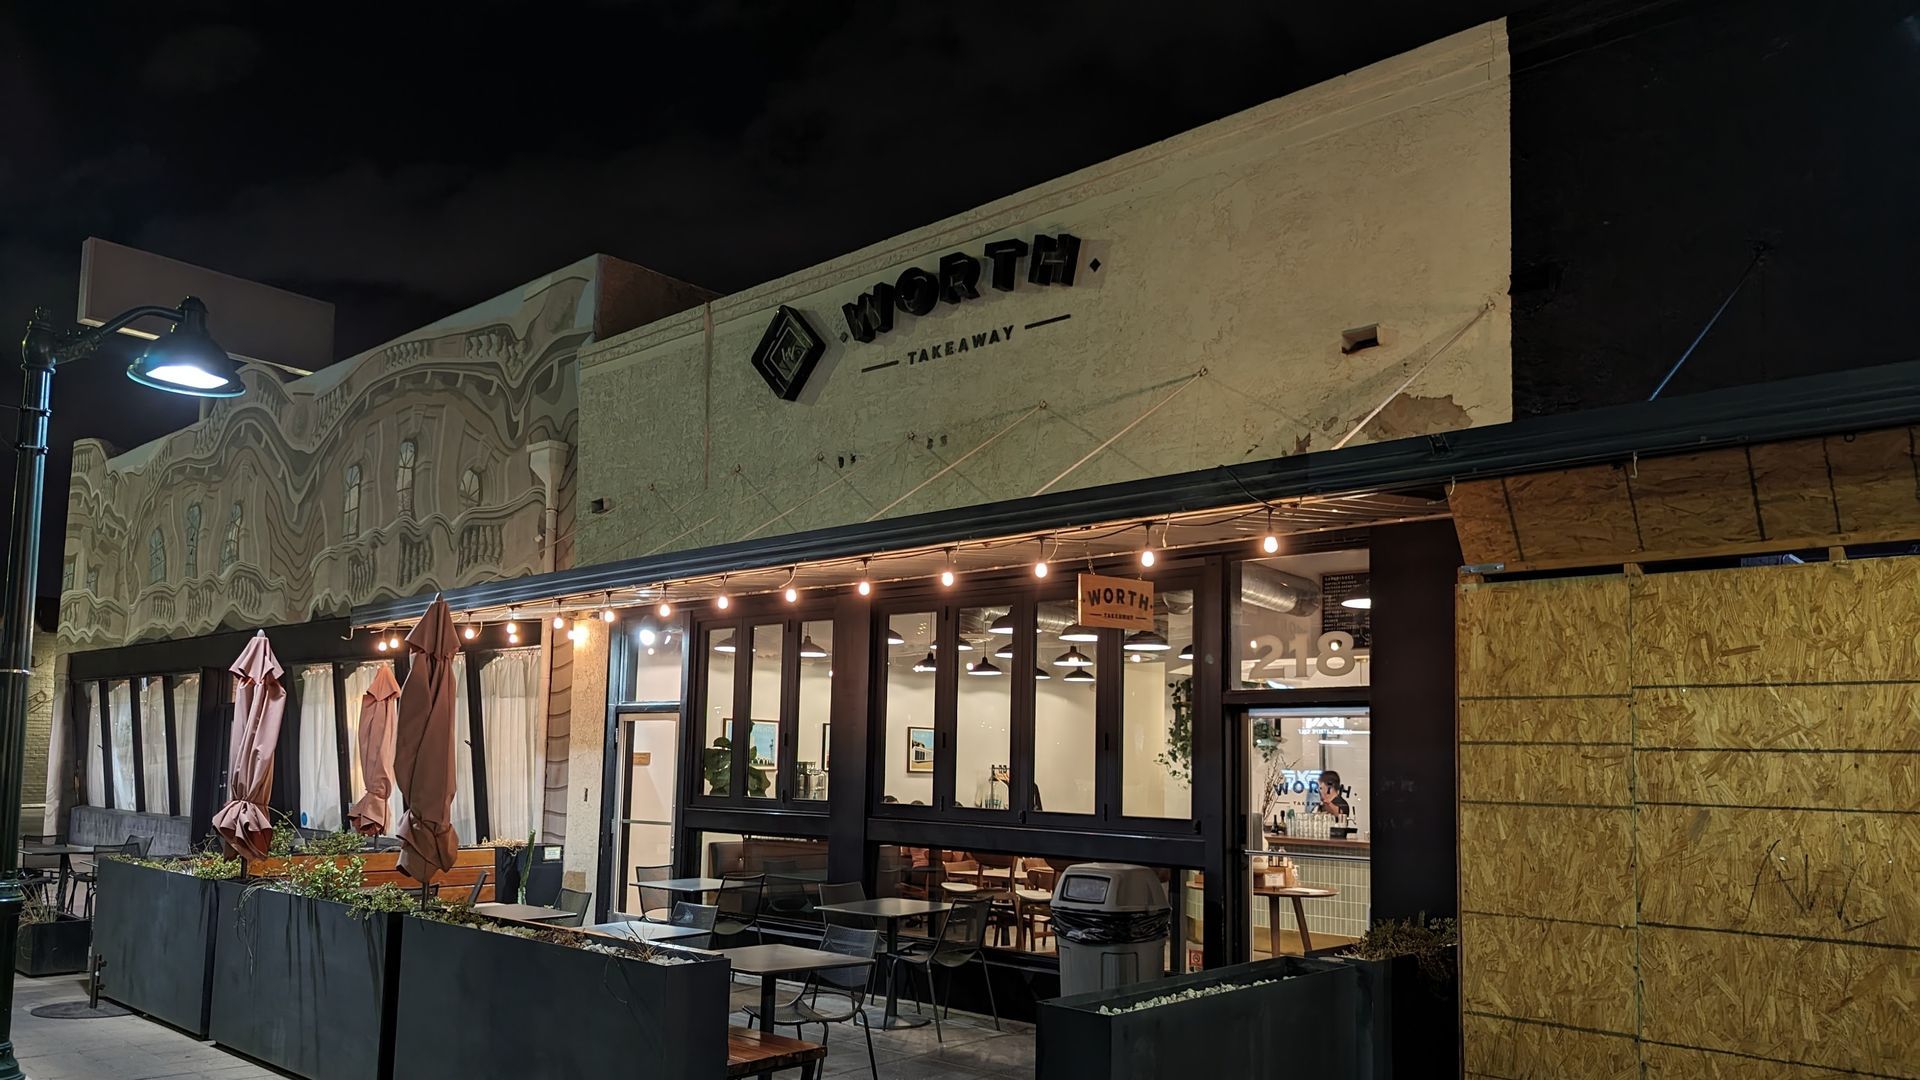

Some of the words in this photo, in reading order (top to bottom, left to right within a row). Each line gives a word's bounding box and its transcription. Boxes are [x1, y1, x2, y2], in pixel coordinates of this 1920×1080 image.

[841, 233, 1081, 343] WORTH
[906, 324, 1015, 365] TAKEAWAY
[1087, 587, 1149, 611] WORTH
[1249, 630, 1356, 680] 218
